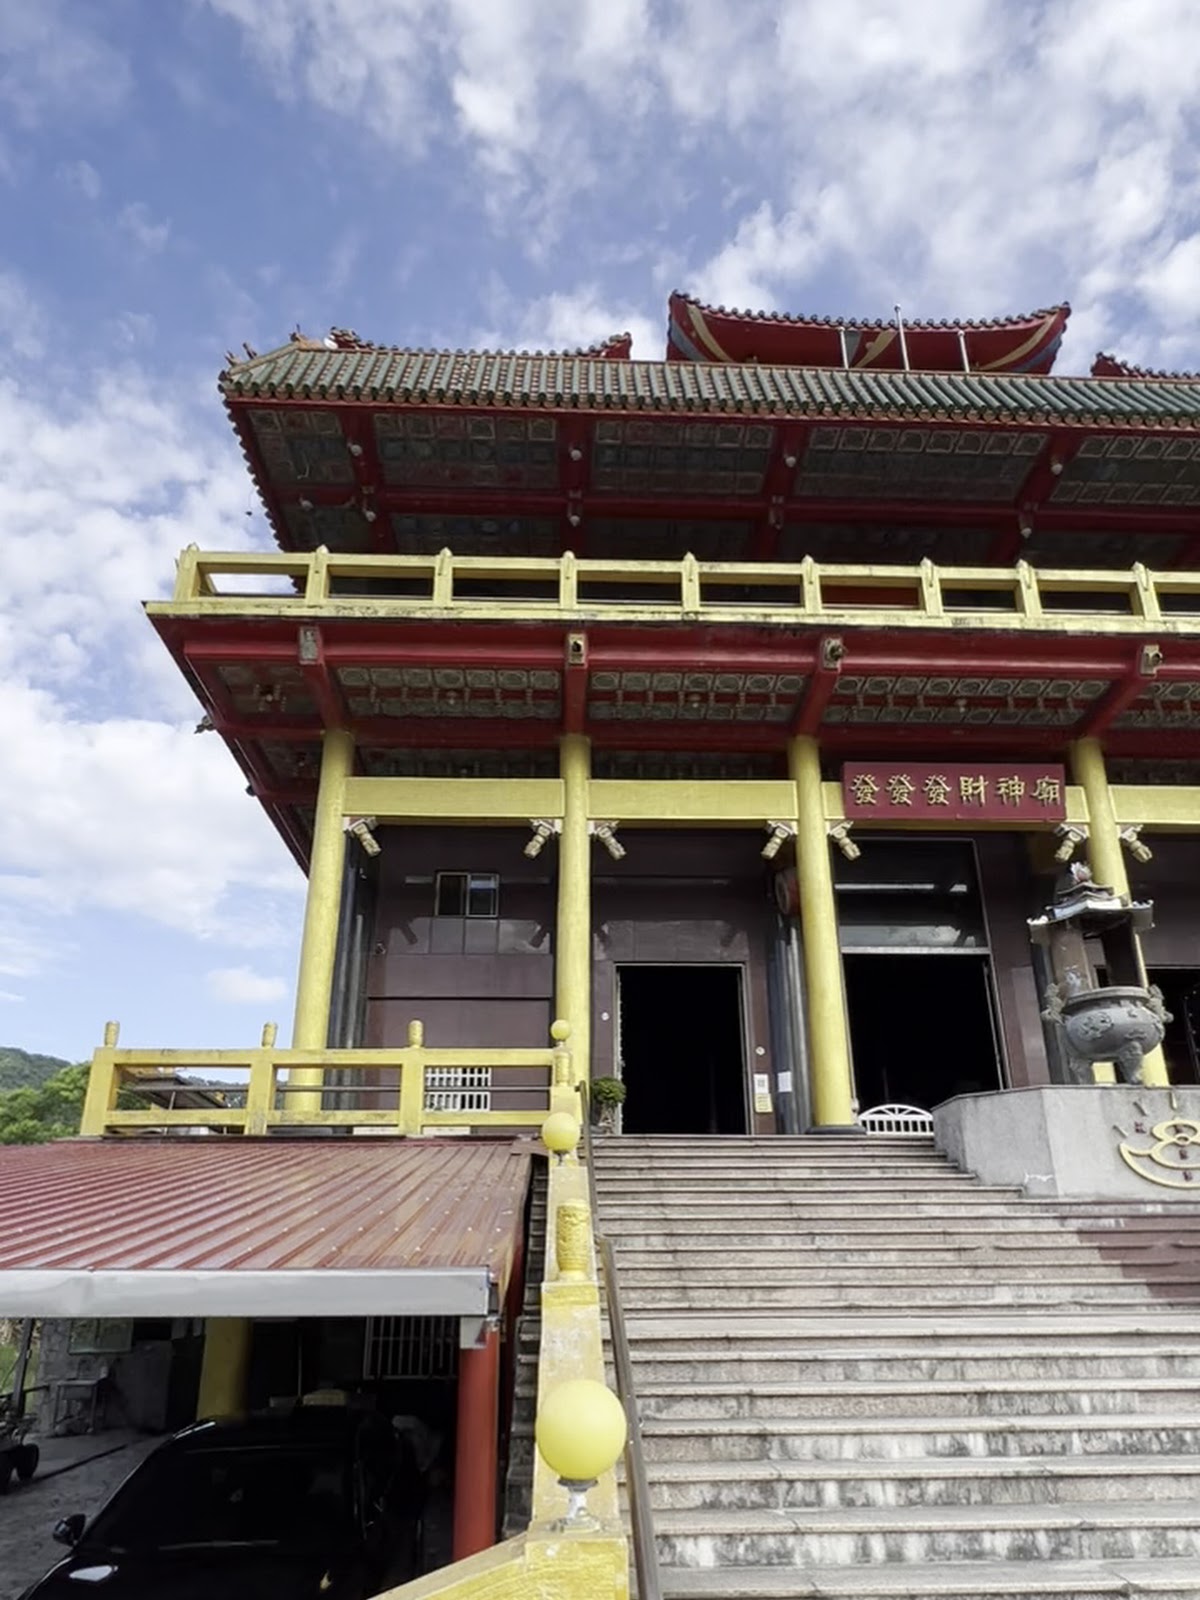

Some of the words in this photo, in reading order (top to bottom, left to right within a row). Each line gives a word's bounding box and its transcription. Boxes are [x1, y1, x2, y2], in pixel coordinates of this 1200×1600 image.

[851, 773, 1060, 806] 發發發財神廟
